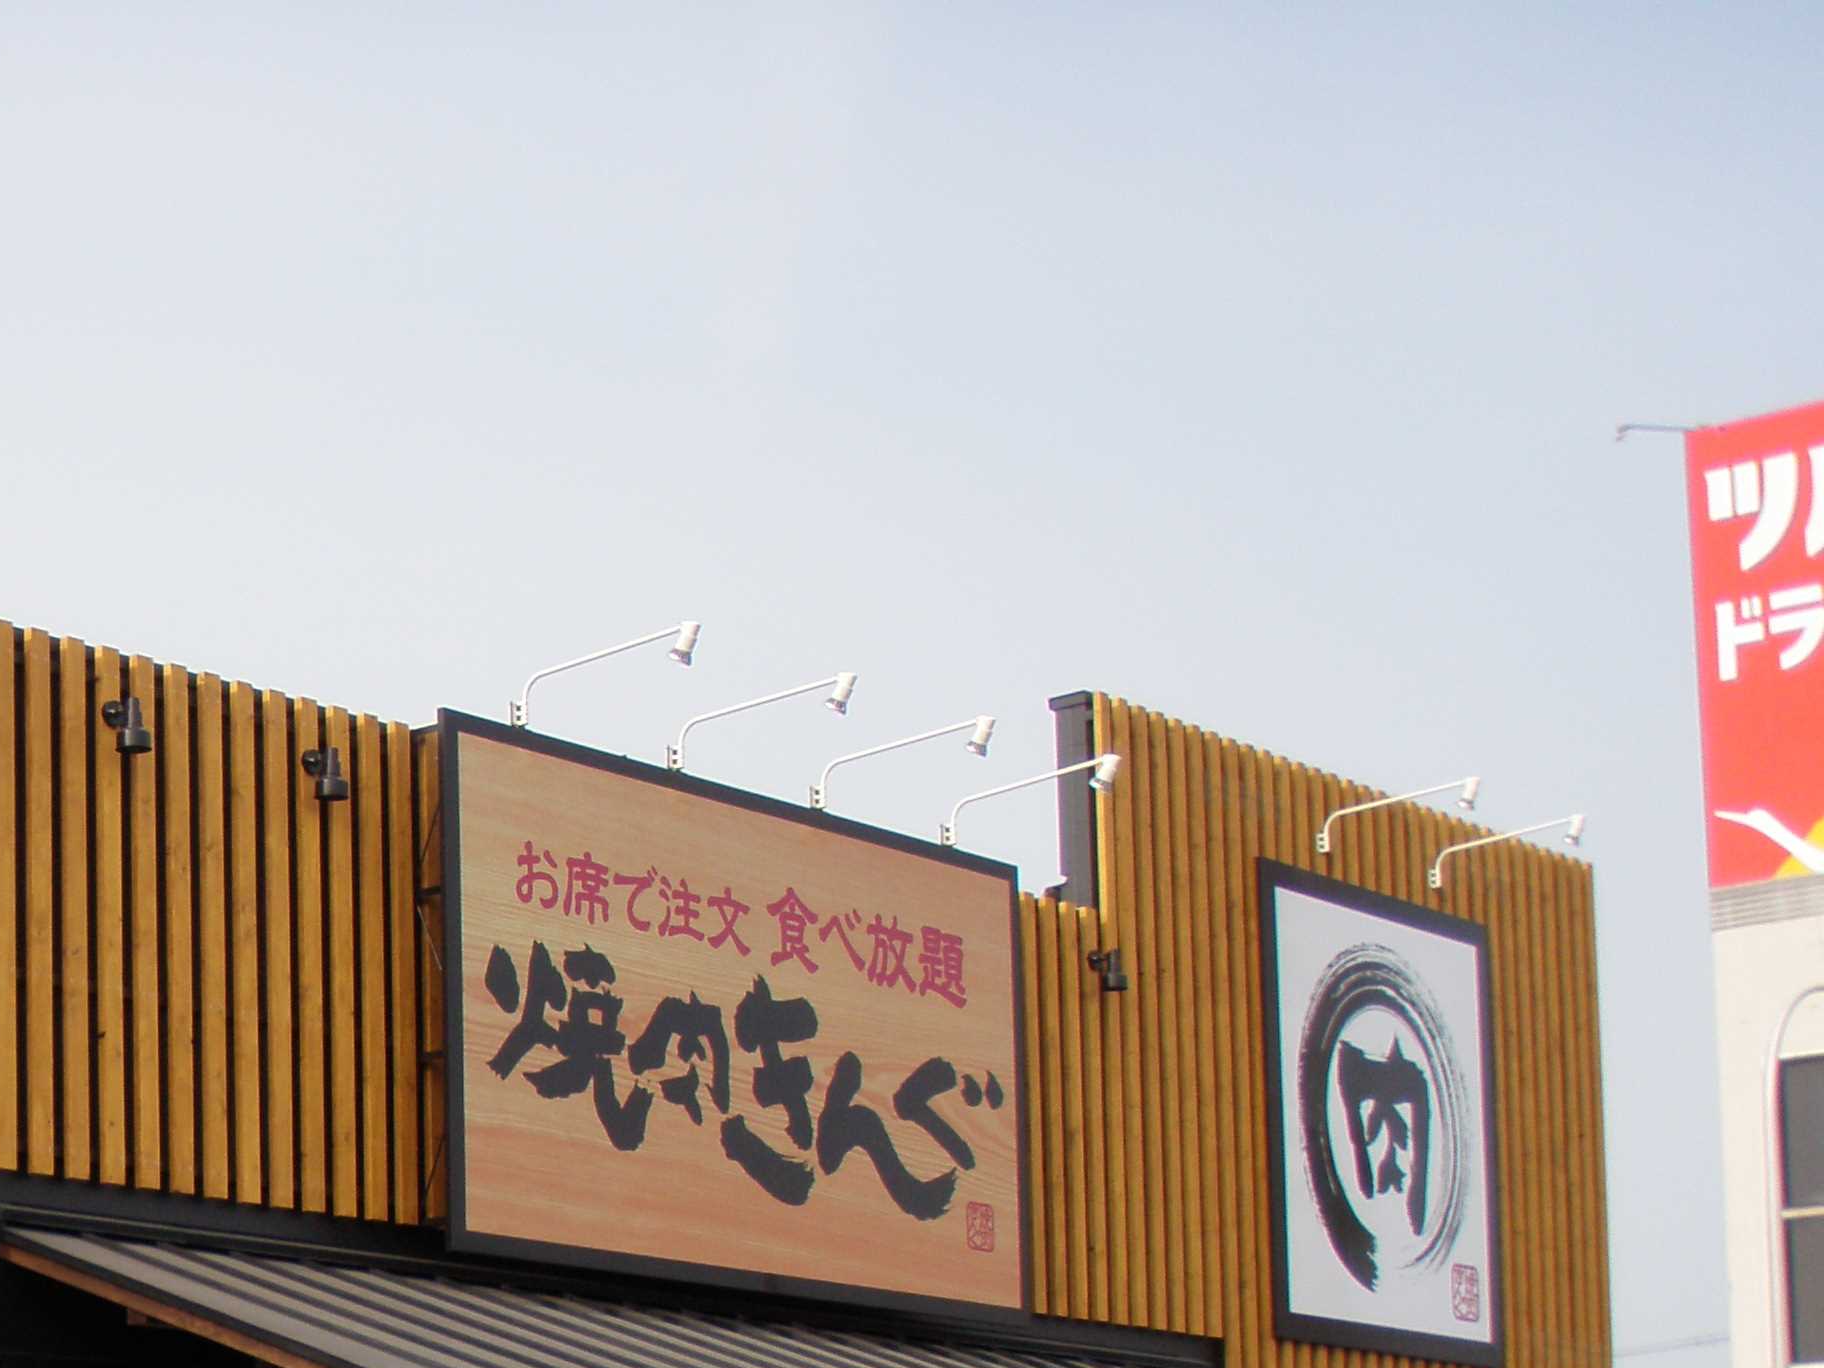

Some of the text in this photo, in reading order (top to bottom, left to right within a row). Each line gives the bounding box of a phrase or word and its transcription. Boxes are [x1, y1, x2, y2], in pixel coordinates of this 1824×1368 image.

[1715, 584, 1824, 682] ドラ
[515, 840, 968, 1009] お席で注文 食べ放題
[484, 940, 1005, 1221] 焼肉きんぐ
[1337, 1033, 1430, 1238] 肉
